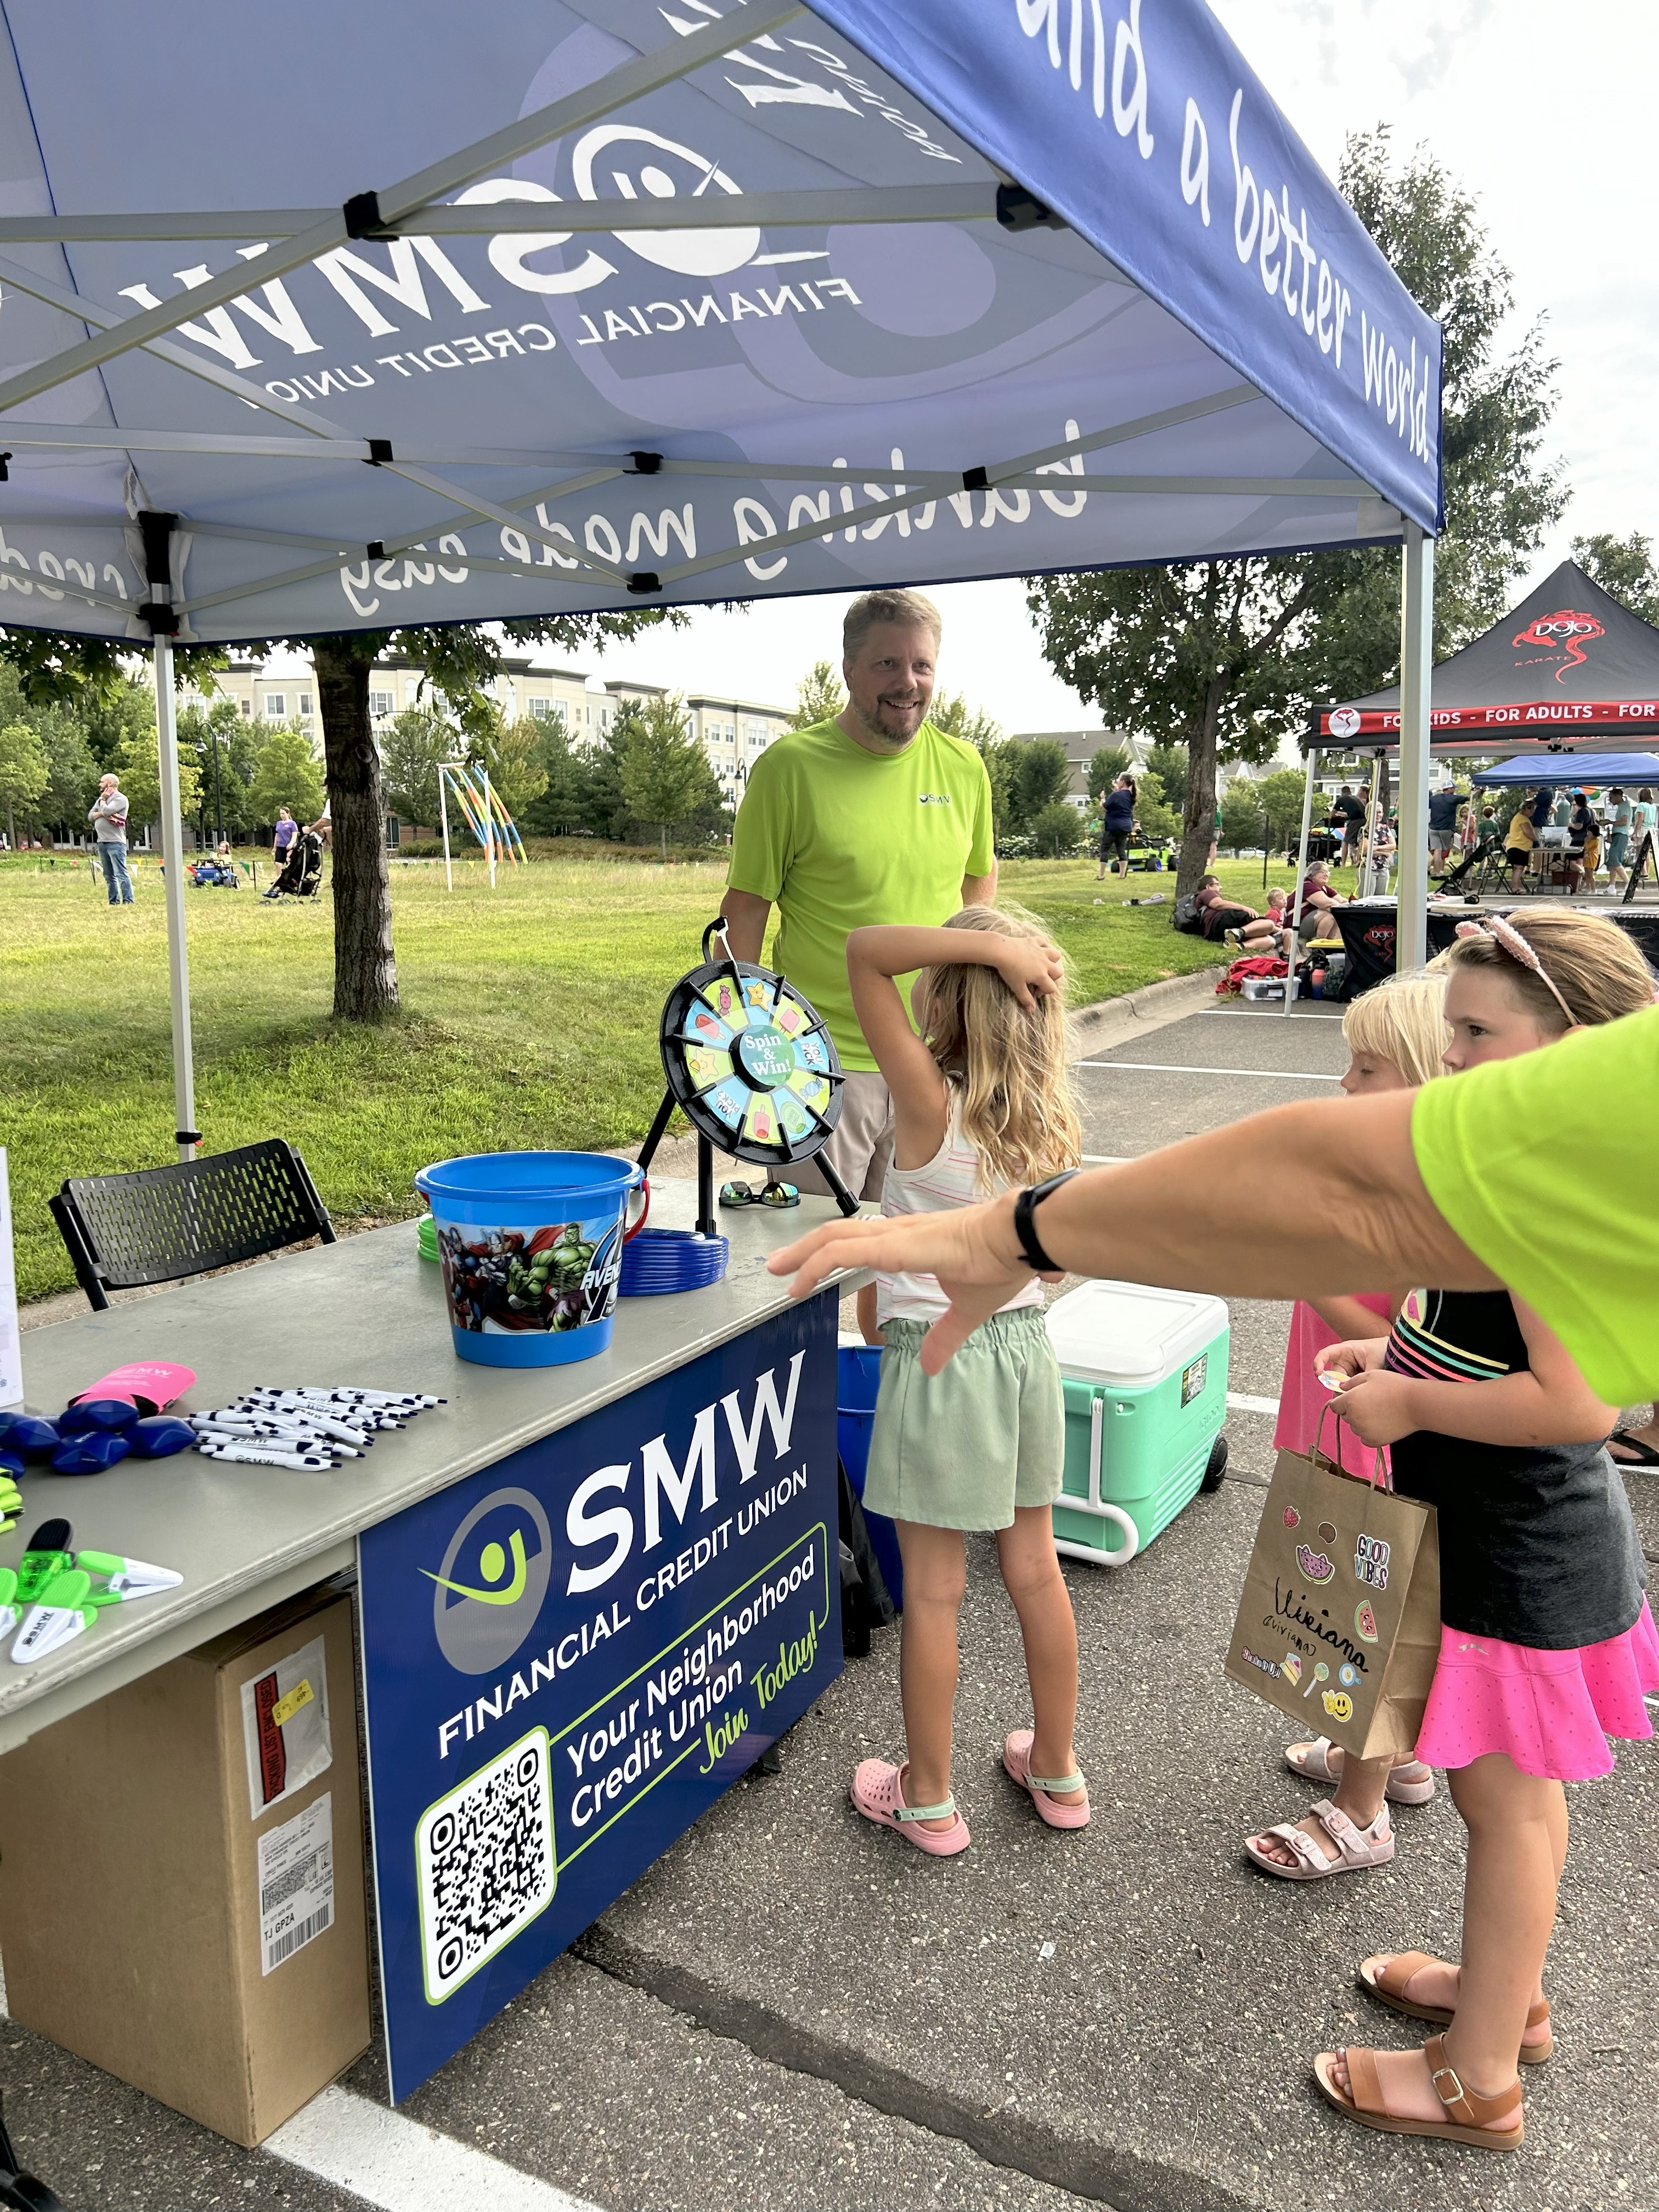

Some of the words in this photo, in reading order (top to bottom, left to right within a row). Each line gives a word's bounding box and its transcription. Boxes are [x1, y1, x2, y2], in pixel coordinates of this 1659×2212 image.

[1181, 97, 1210, 227] a
[1230, 89, 1350, 369] better
[1362, 311, 1428, 463] world
[1515, 656, 1571, 667] KARATE
[1383, 714, 1401, 727] FO
[1485, 709, 1520, 723] FOR
[1525, 705, 1593, 720] ADULTS
[1618, 704, 1656, 718] FOR
[744, 1034, 782, 1051] Spin
[764, 1048, 776, 1060] &
[802, 1043, 816, 1065] PICK
[811, 1042, 823, 1063] YOU
[752, 1058, 792, 1075] Win!
[716, 1088, 724, 1097] 2
[723, 1093, 741, 1114] PICK
[715, 1100, 733, 1119] YOU
[566, 1349, 806, 1596] SMW
[1358, 1536, 1388, 1565] GOOD
[1355, 1556, 1387, 1589] VIBES
[29, 1611, 52, 1638] SMW
[438, 1600, 631, 1760] FINANCIAL
[637, 1516, 732, 1611] CREDIT
[737, 1463, 807, 1537] UNION
[567, 1698, 640, 1778] Your
[647, 1543, 815, 1718] Neighborhood
[1242, 1646, 1262, 1668] Shake
[1268, 1661, 1281, 1679] Up!
[699, 1707, 749, 1774] Join
[751, 1610, 818, 1709] Today!
[260, 1680, 275, 1734] ENCLOSED
[264, 1732, 277, 1756] LIST
[571, 1728, 663, 1827] Credit
[668, 1660, 743, 1742] Union
[264, 1928, 273, 1941] TJ
[275, 1912, 295, 1933] GPZA
